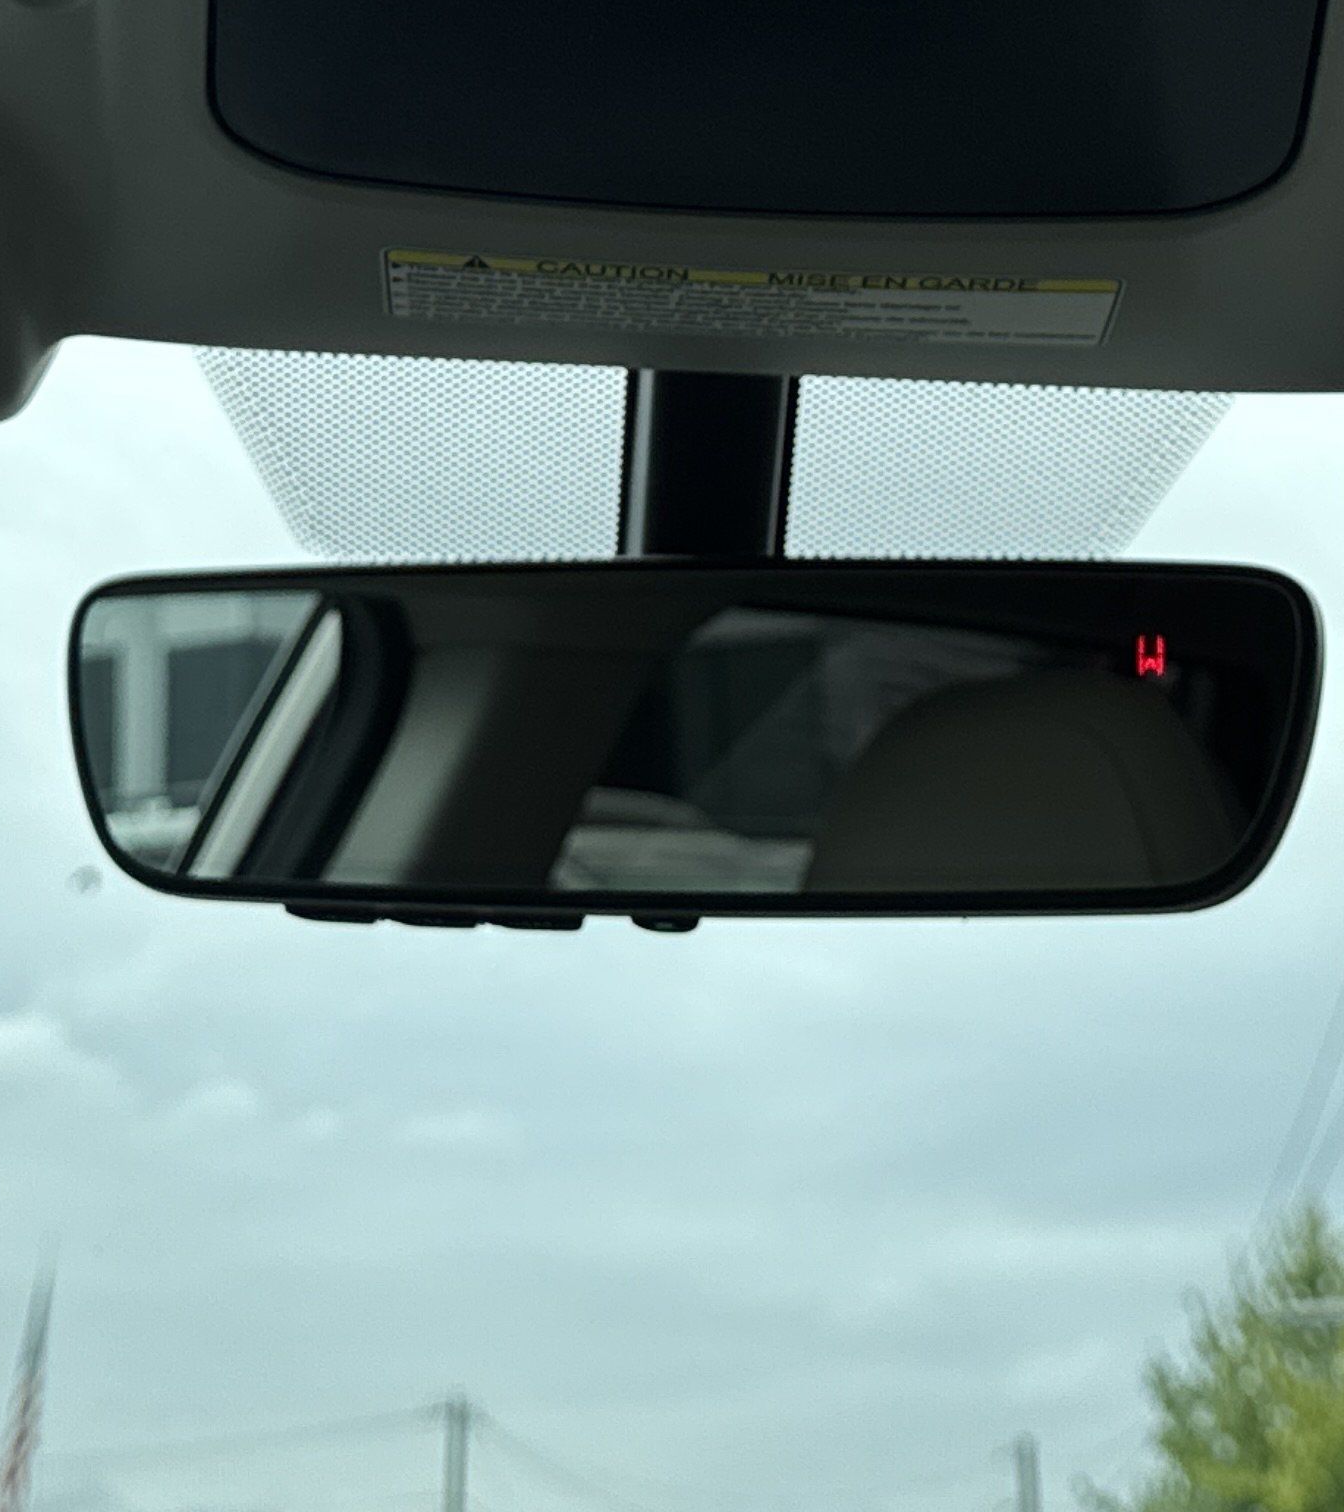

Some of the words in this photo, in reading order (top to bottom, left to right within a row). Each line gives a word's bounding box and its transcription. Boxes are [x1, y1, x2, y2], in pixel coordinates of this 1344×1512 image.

[537, 260, 688, 281] CAUTION
[769, 272, 849, 289] MISE
[863, 275, 907, 289] EN
[918, 277, 1039, 292] GARDE
[1136, 633, 1166, 678] W
